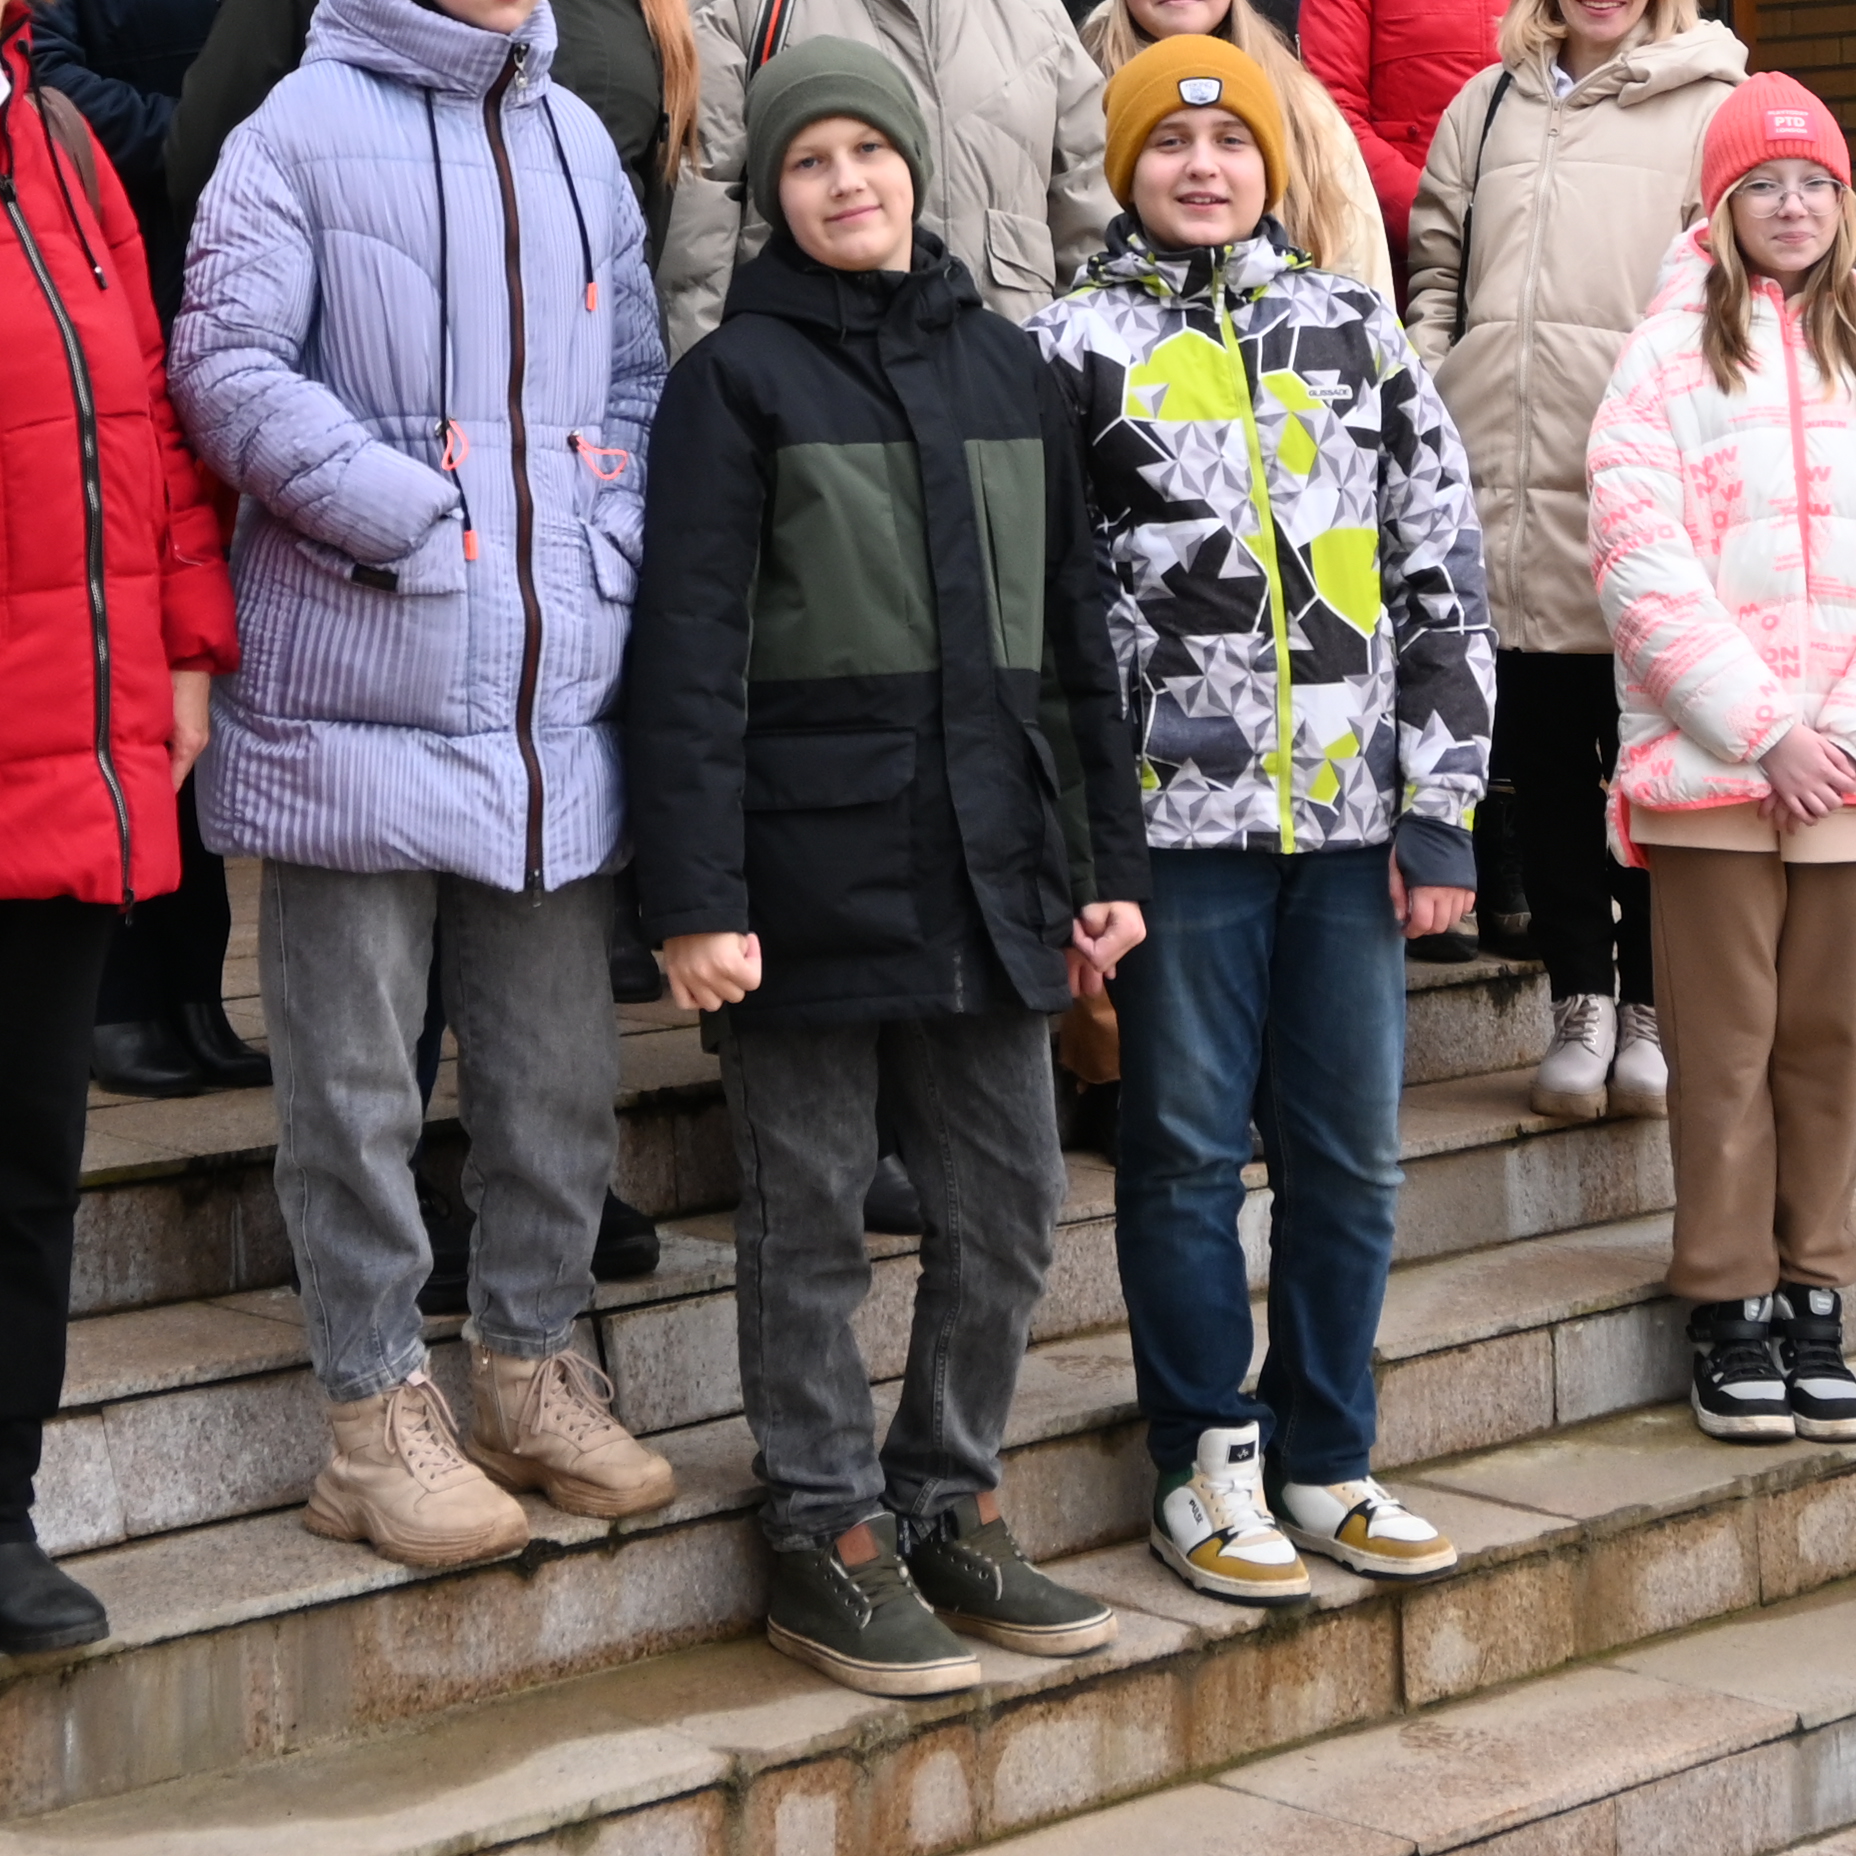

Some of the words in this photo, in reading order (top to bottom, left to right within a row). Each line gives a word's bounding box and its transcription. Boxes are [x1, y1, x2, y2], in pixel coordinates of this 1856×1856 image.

[1775, 116, 1806, 127] PTD
[1308, 388, 1349, 397] GLISSADE
[1188, 1498, 1204, 1526] PULSE
